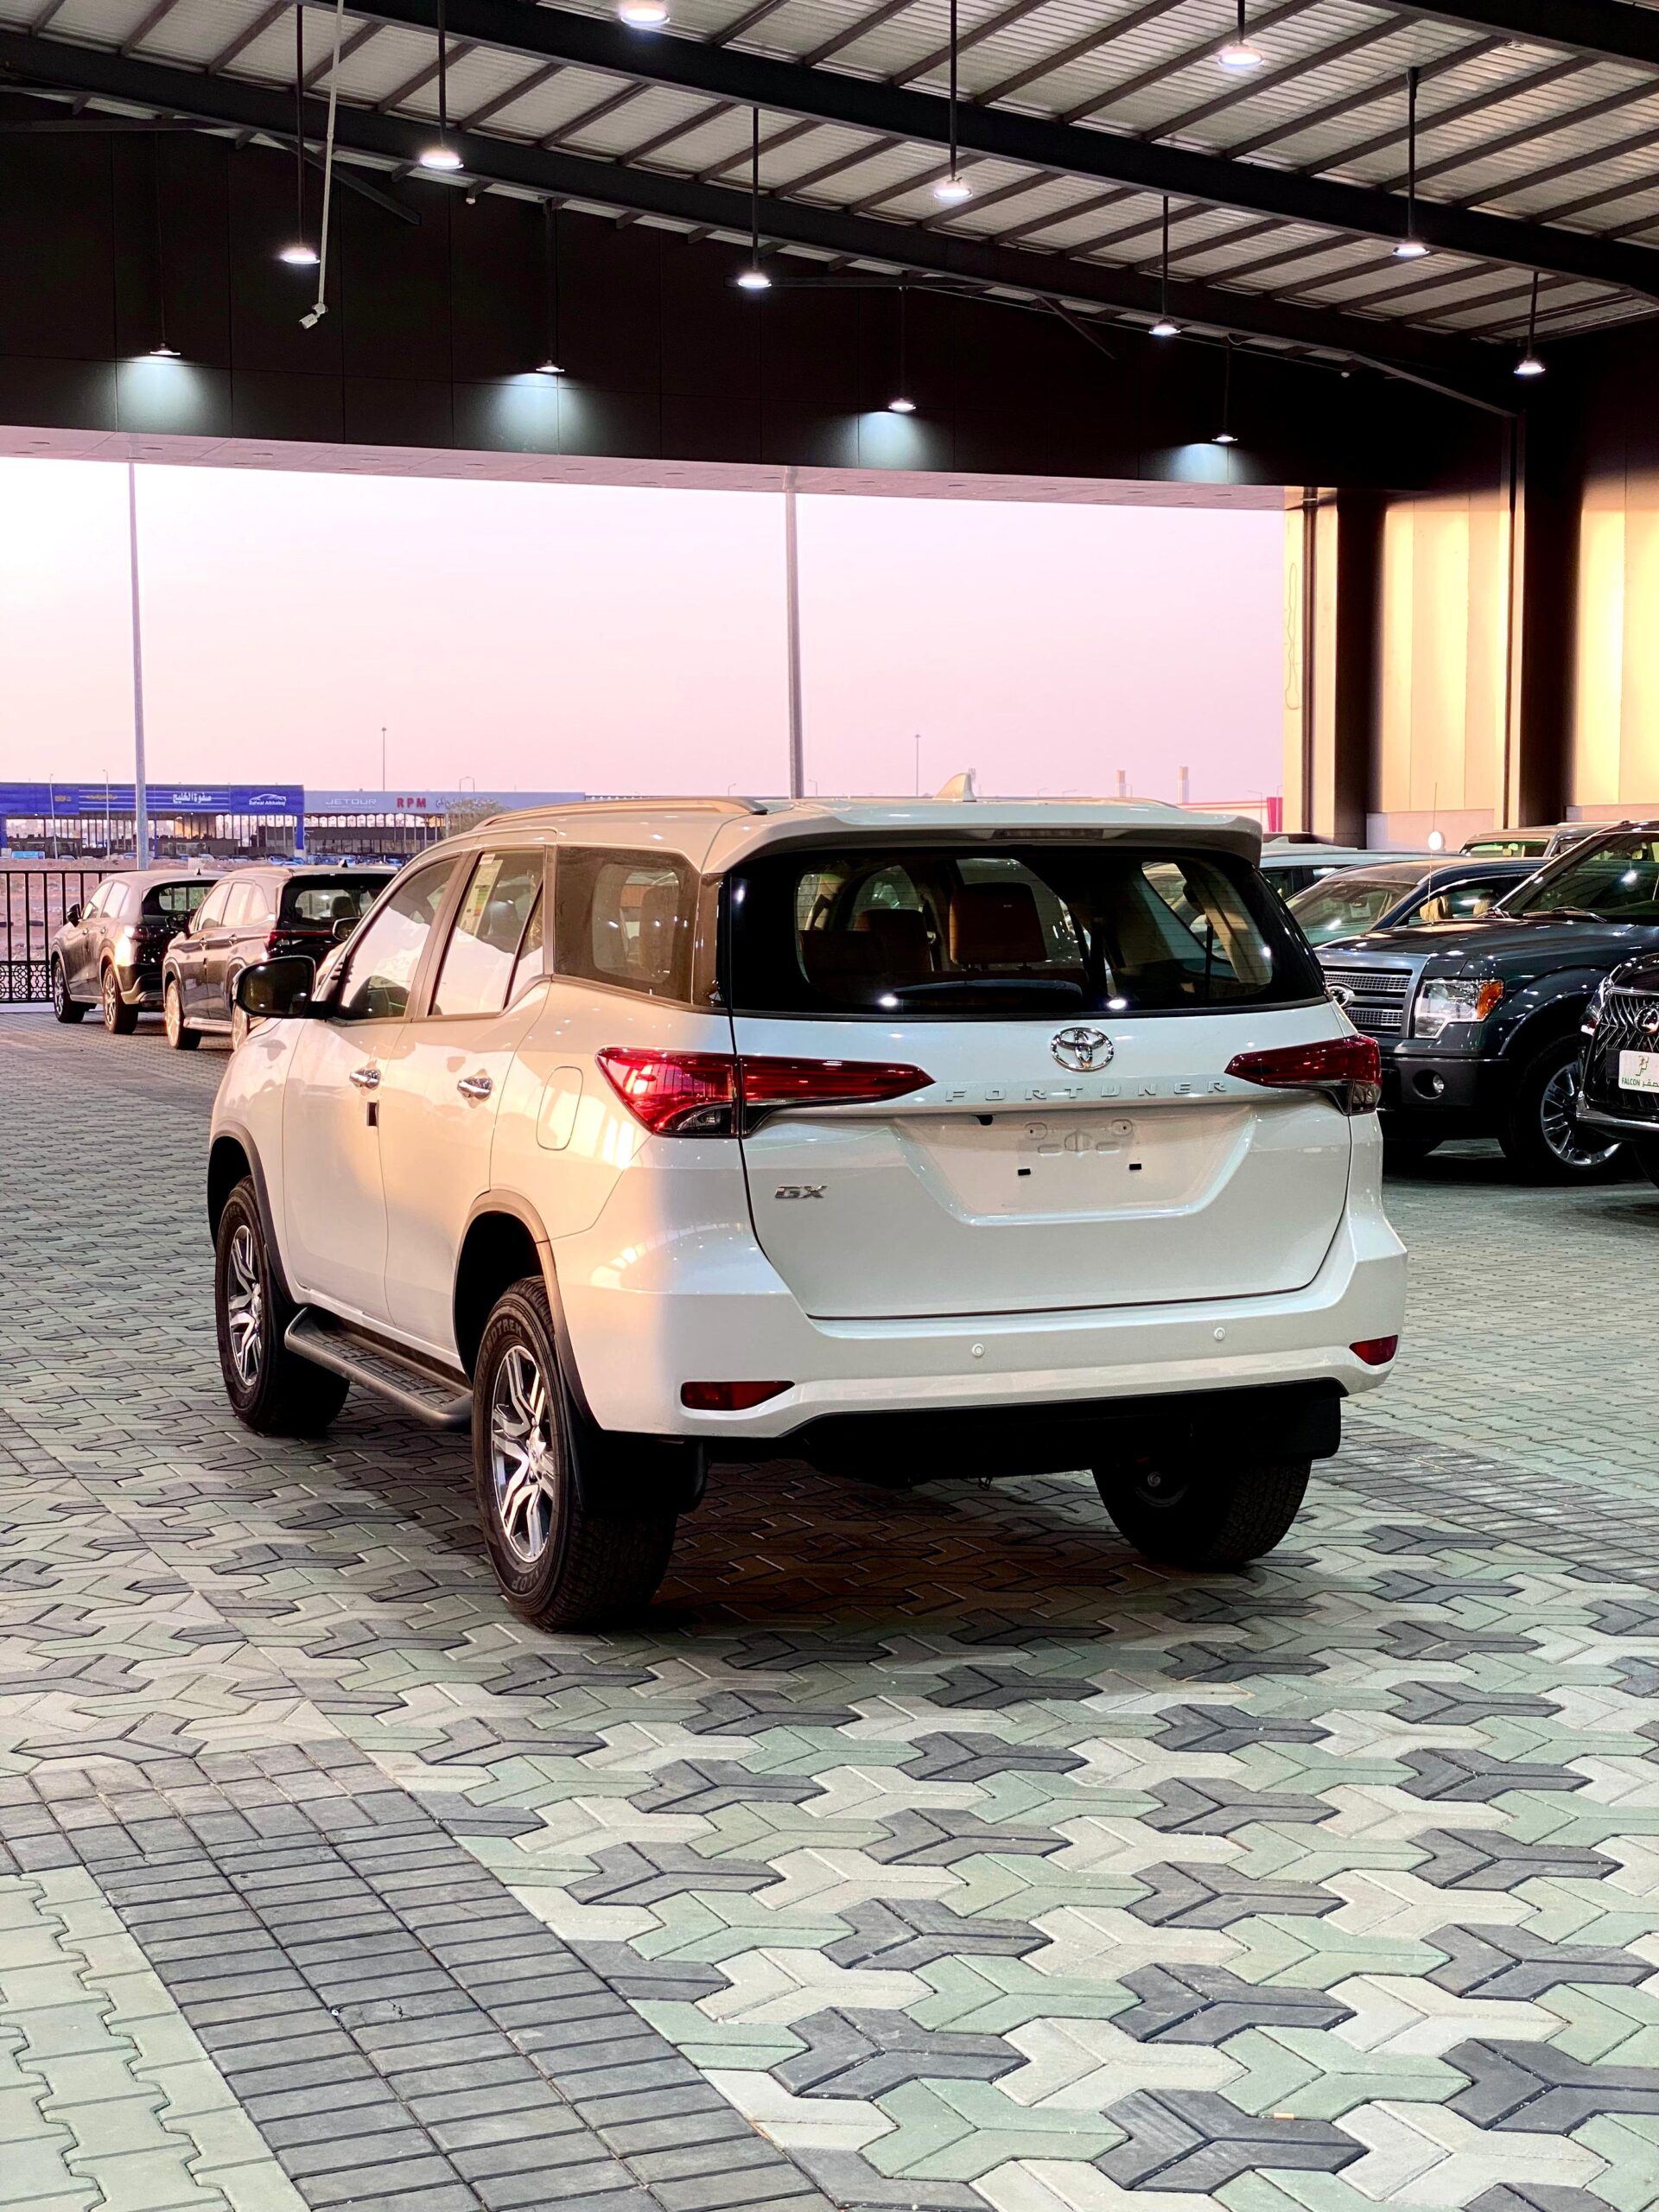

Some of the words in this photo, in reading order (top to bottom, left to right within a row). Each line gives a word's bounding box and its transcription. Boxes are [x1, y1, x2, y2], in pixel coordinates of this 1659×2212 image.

[397, 798, 427, 808] RPM
[1621, 1077, 1640, 1086] FALCON
[1643, 1078, 1659, 1088] صقر
[945, 1080, 1227, 1102] FORTUNER
[775, 1185, 828, 1199] GX
